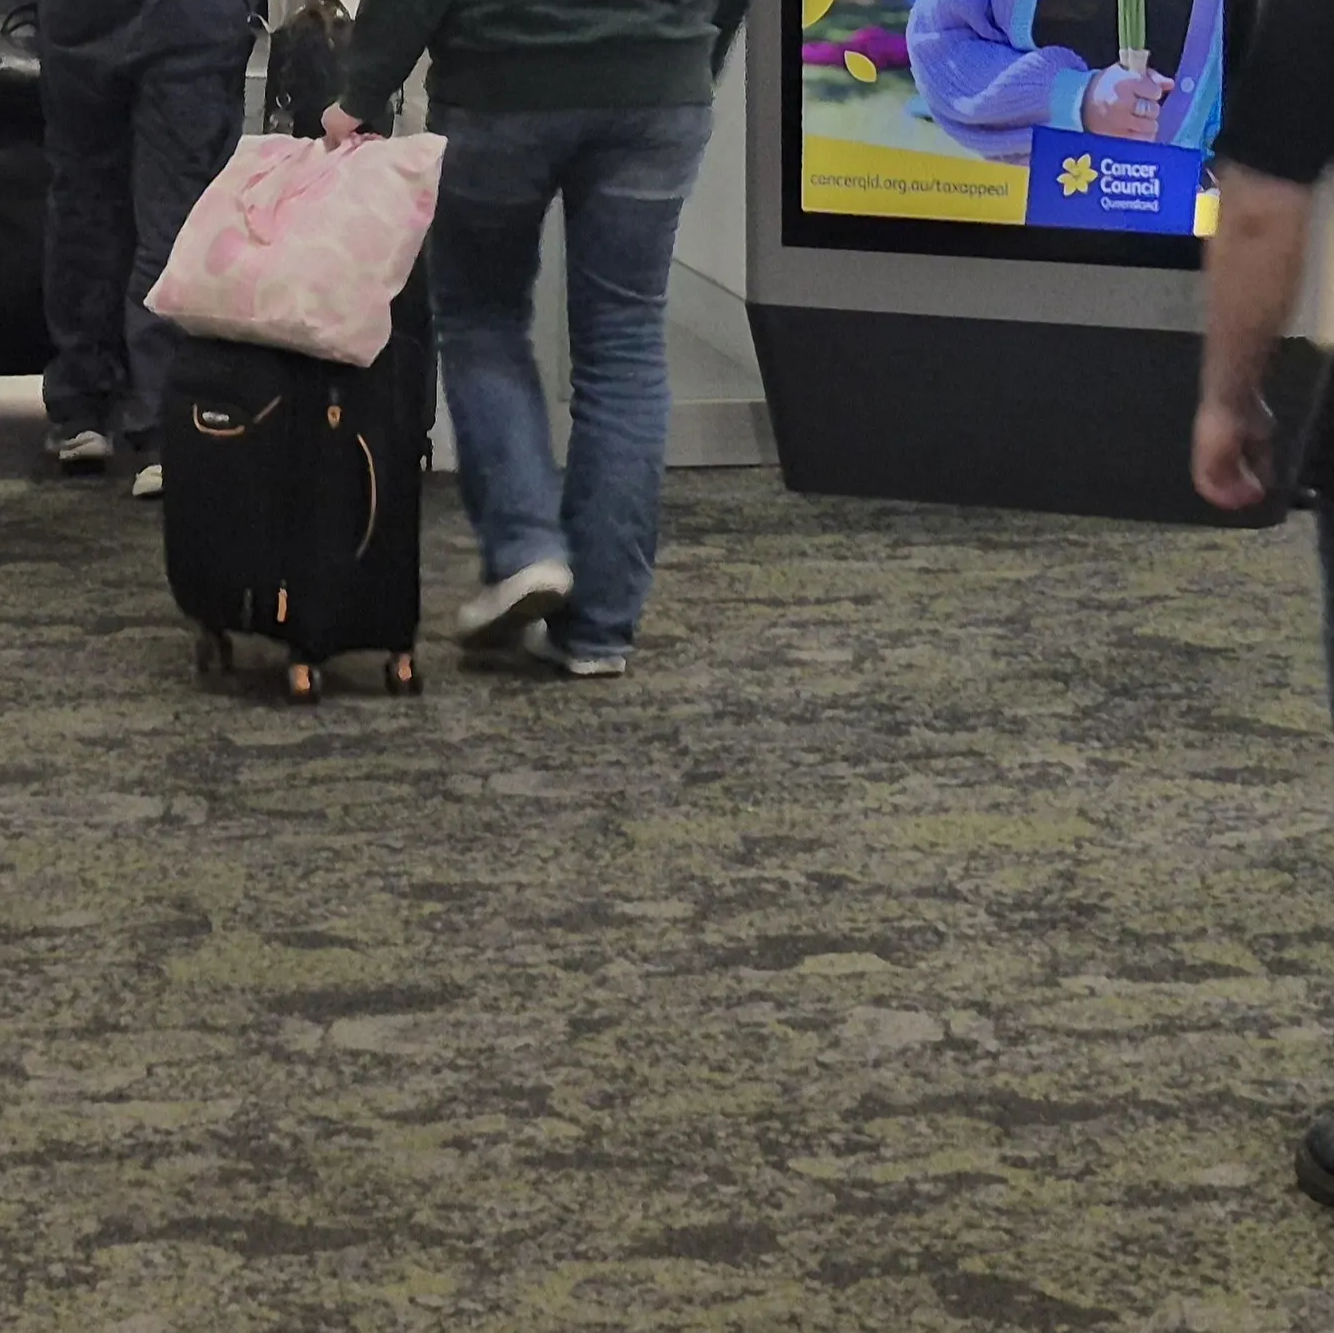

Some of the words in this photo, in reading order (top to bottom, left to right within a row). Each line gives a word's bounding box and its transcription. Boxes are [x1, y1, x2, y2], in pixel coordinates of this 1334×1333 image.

[1100, 157, 1158, 179] Cancer
[809, 172, 1009, 198] cancerqld.org.au/taxappeal
[1100, 175, 1161, 198] Council
